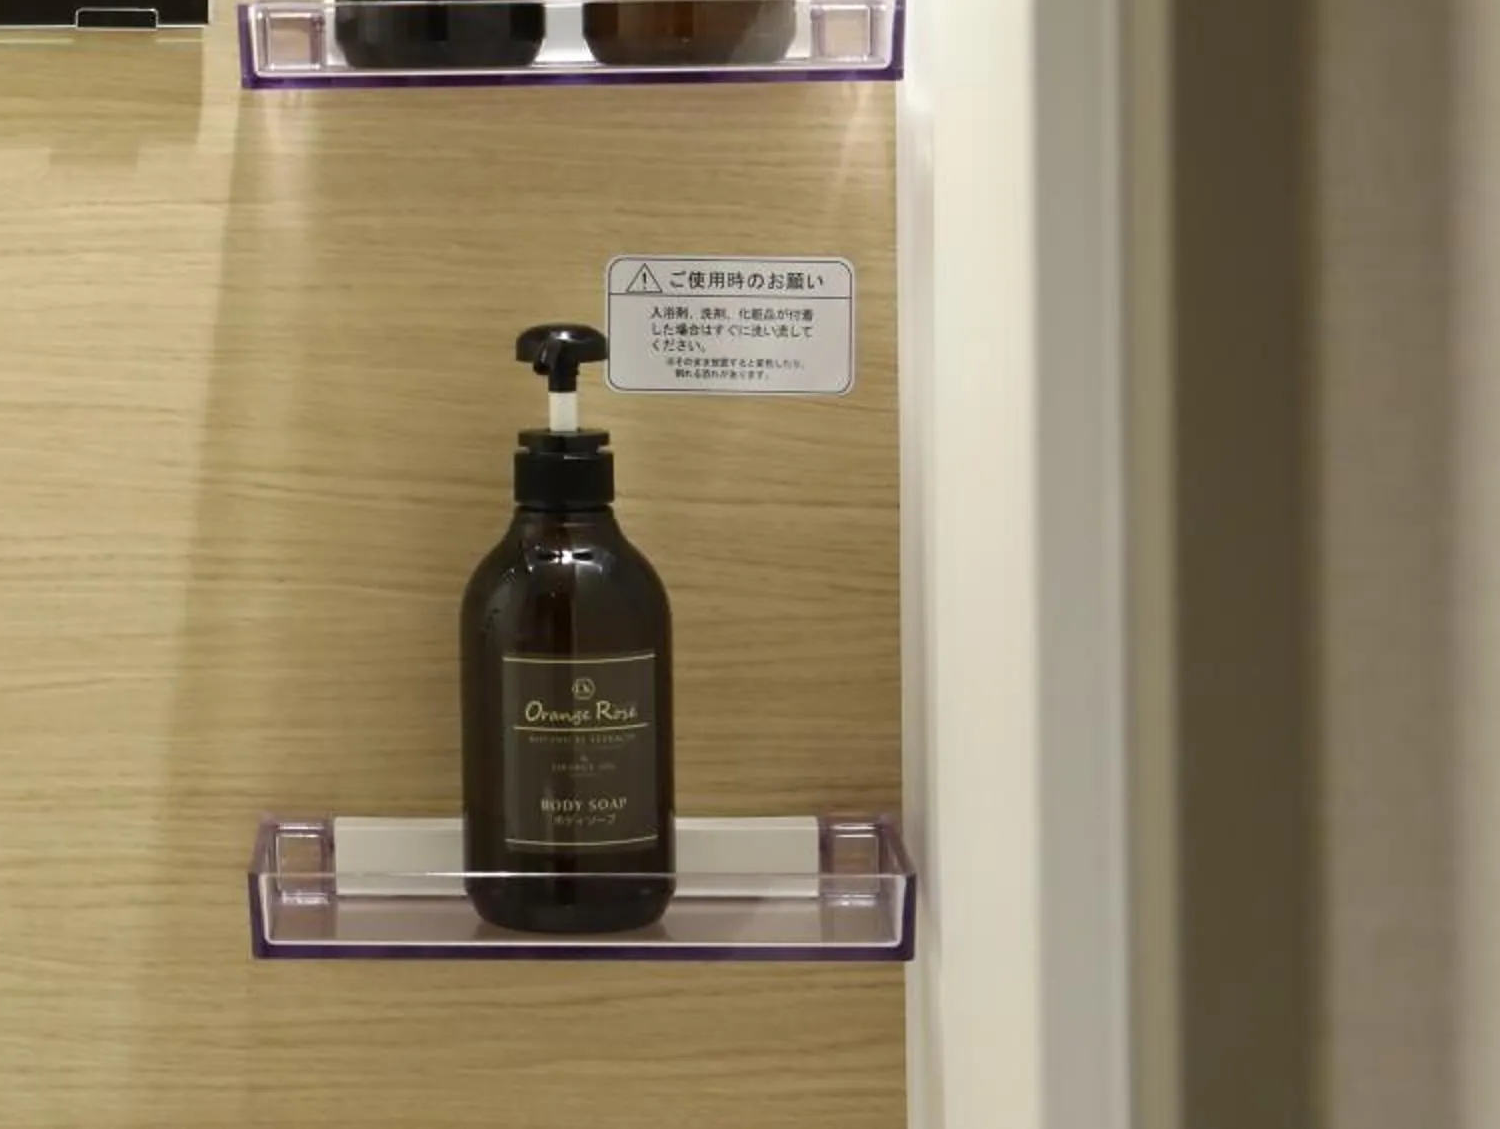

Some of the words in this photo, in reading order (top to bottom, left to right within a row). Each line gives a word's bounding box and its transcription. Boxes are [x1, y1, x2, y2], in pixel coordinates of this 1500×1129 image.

[669, 271, 825, 291] ご使用時のお願い
[651, 324, 813, 338] した場合はすぐに洗い流して
[651, 340, 707, 354] ください。
[525, 700, 592, 725] Orange
[541, 798, 584, 812] BODY
[588, 797, 628, 811] SOAP
